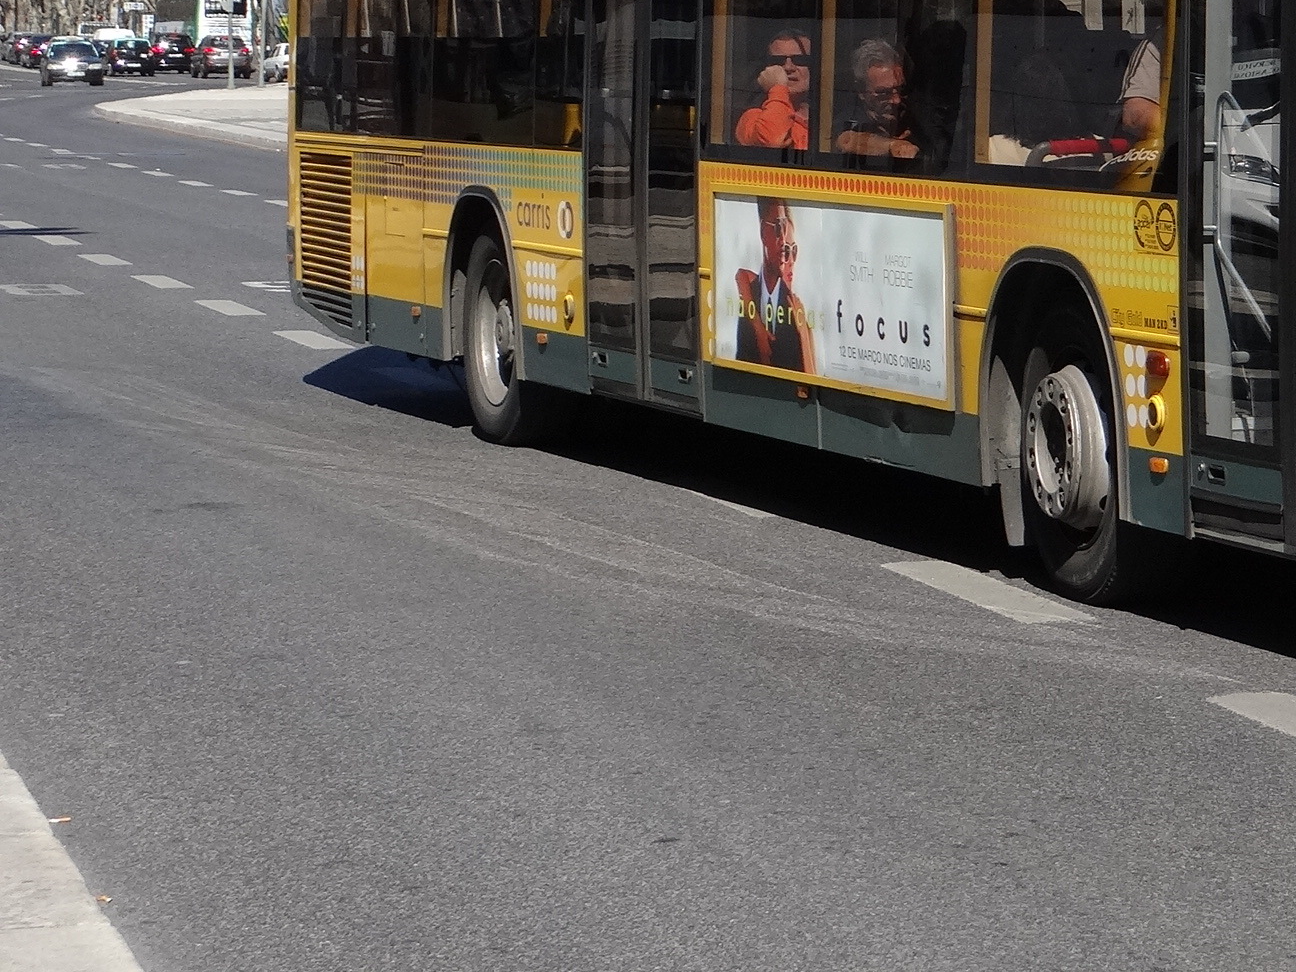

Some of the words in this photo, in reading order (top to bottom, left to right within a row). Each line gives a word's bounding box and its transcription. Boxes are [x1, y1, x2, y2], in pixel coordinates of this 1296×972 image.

[516, 193, 551, 230] carris
[884, 254, 912, 269] MARGOT
[849, 264, 875, 284] SMITH
[883, 268, 914, 289] ROBBIE
[726, 294, 756, 319] não
[836, 299, 931, 347] focus
[838, 345, 847, 358] 12
[847, 346, 857, 359] DE
[857, 348, 883, 365] MARÇO
[883, 352, 898, 366] NOS
[899, 354, 931, 372] CINEMAS
